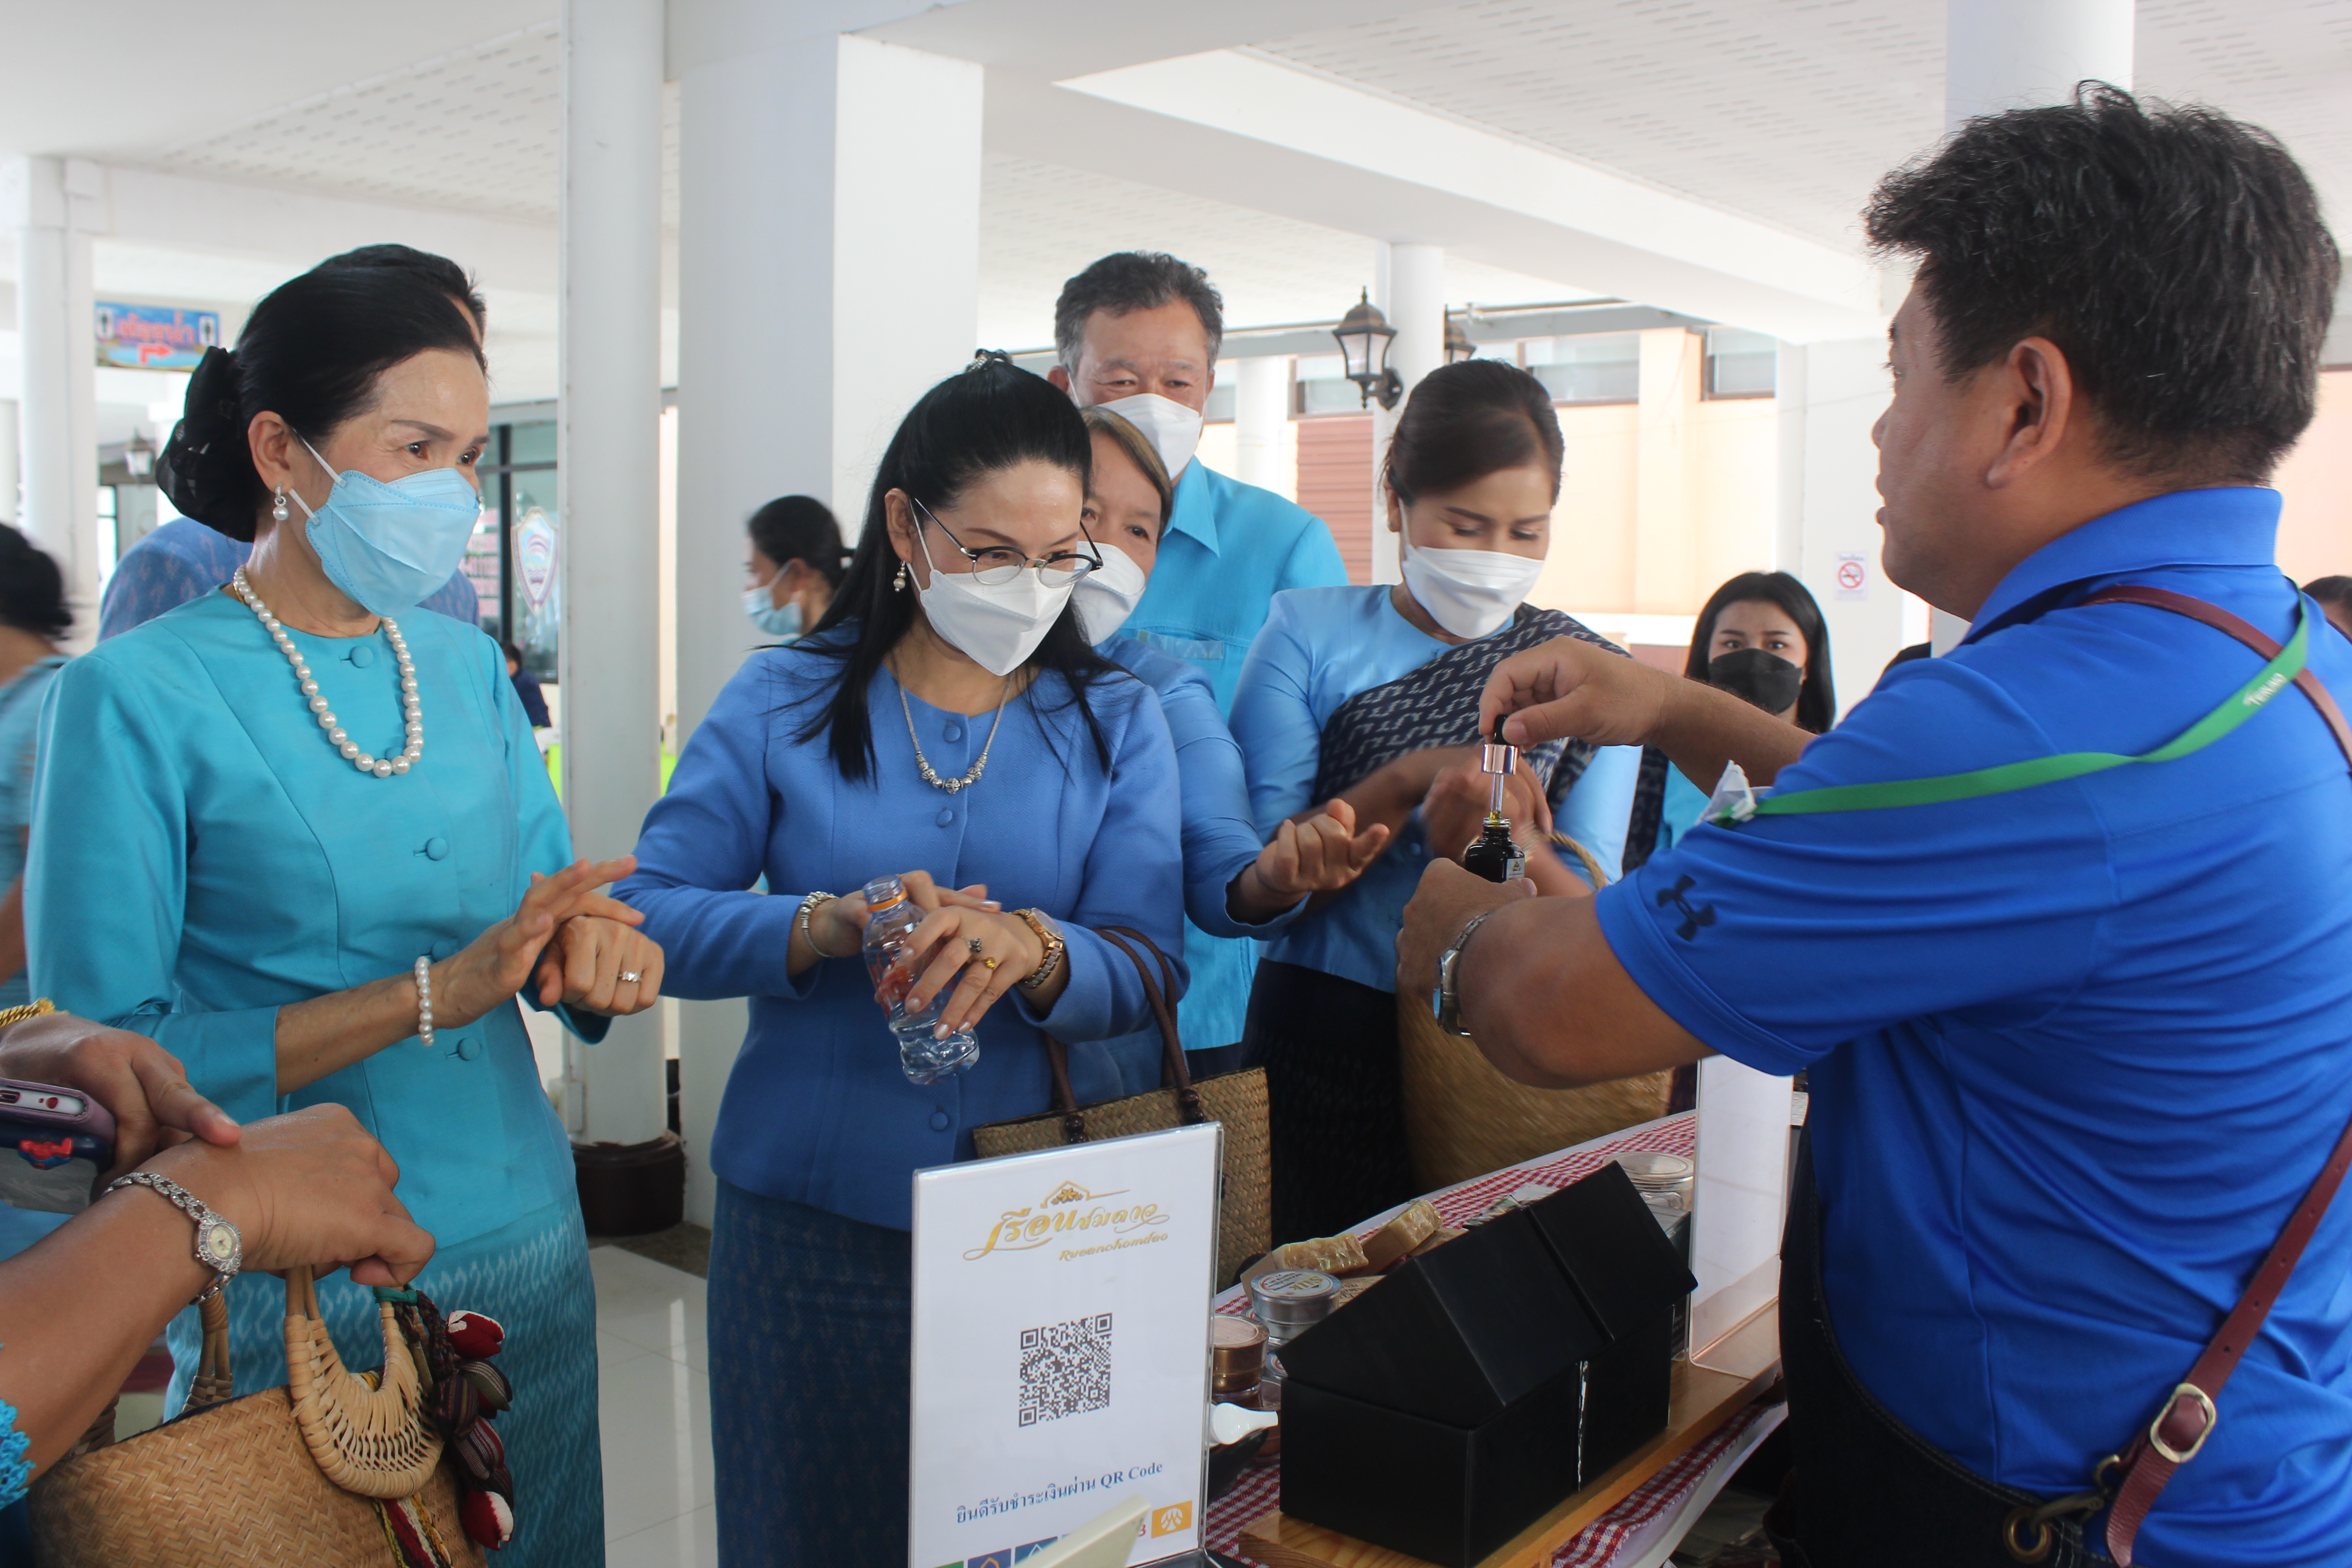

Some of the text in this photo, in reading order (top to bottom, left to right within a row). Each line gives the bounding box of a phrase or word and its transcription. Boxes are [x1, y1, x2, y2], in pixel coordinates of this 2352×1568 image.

[957, 1462, 1163, 1524] ยินดีรับชำระเงินผ่าน QR Code
